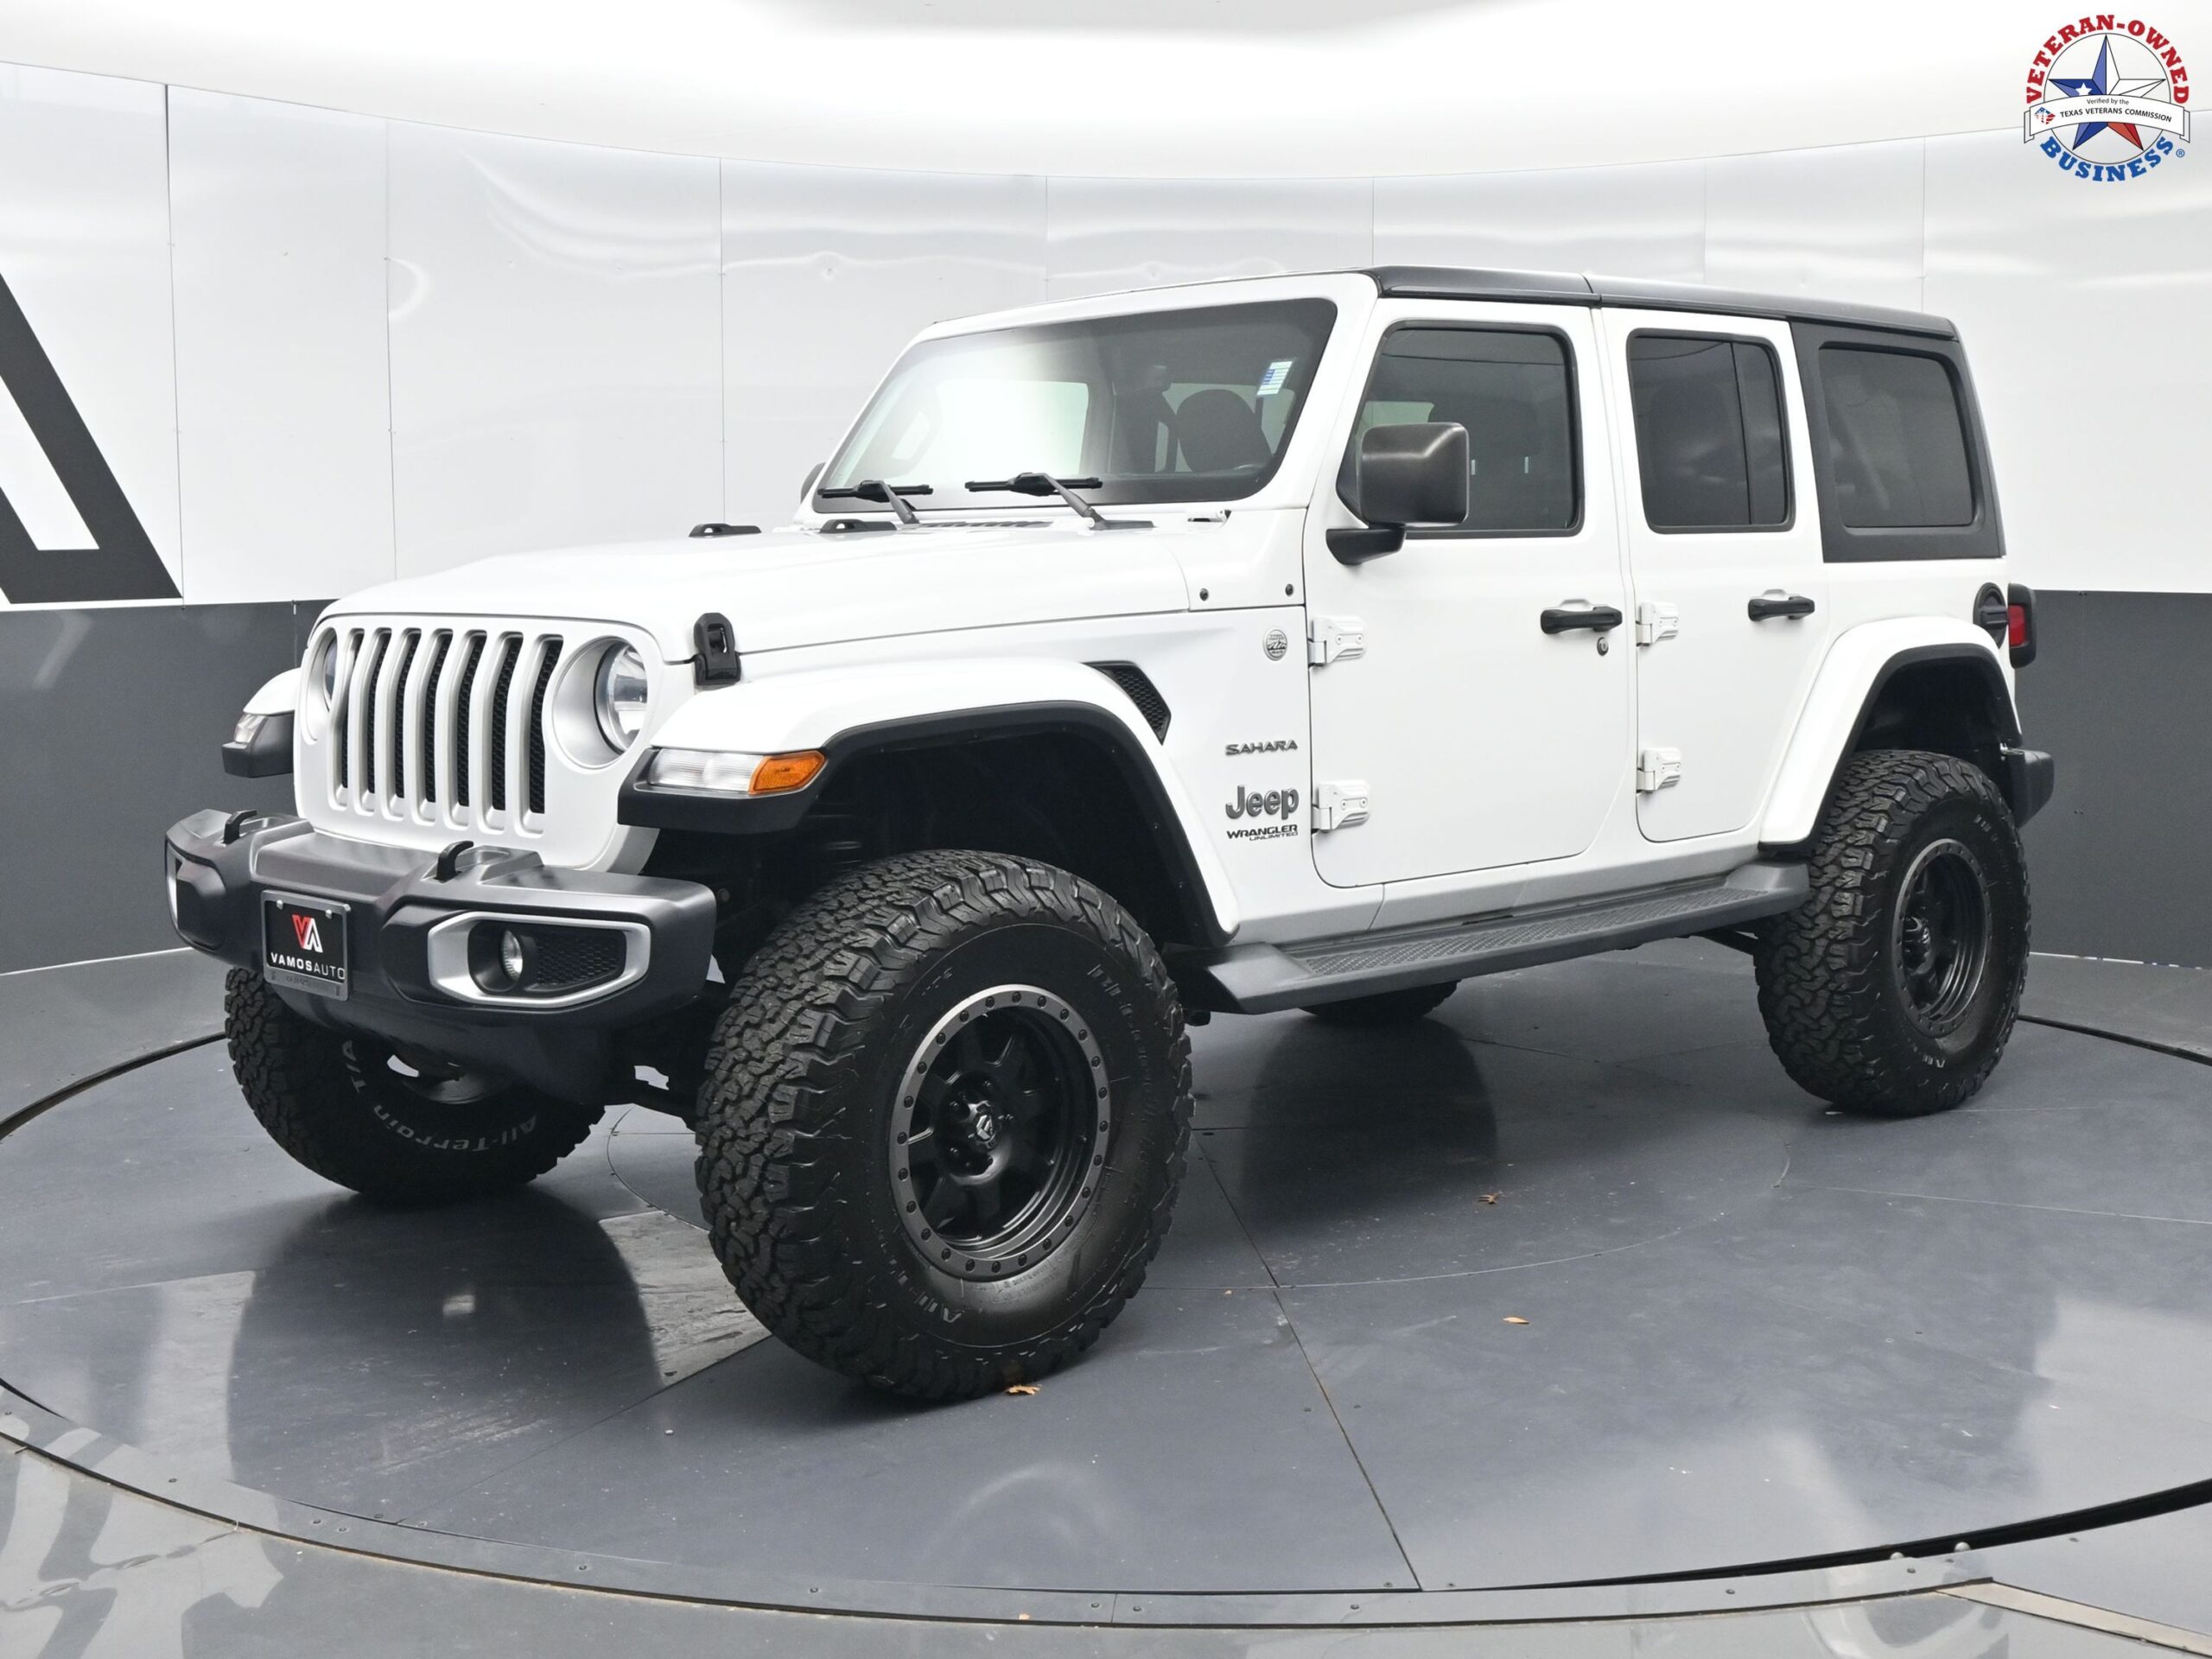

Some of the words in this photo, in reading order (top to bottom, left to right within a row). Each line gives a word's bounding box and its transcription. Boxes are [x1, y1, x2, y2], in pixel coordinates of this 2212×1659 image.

[1225, 740, 1298, 756] SAHARA
[1225, 785, 1299, 820] Jeep
[1226, 824, 1298, 839] WRANGLER
[1249, 831, 1298, 842] UNLIMITED
[373, 1105, 537, 1152] All-Terrain
